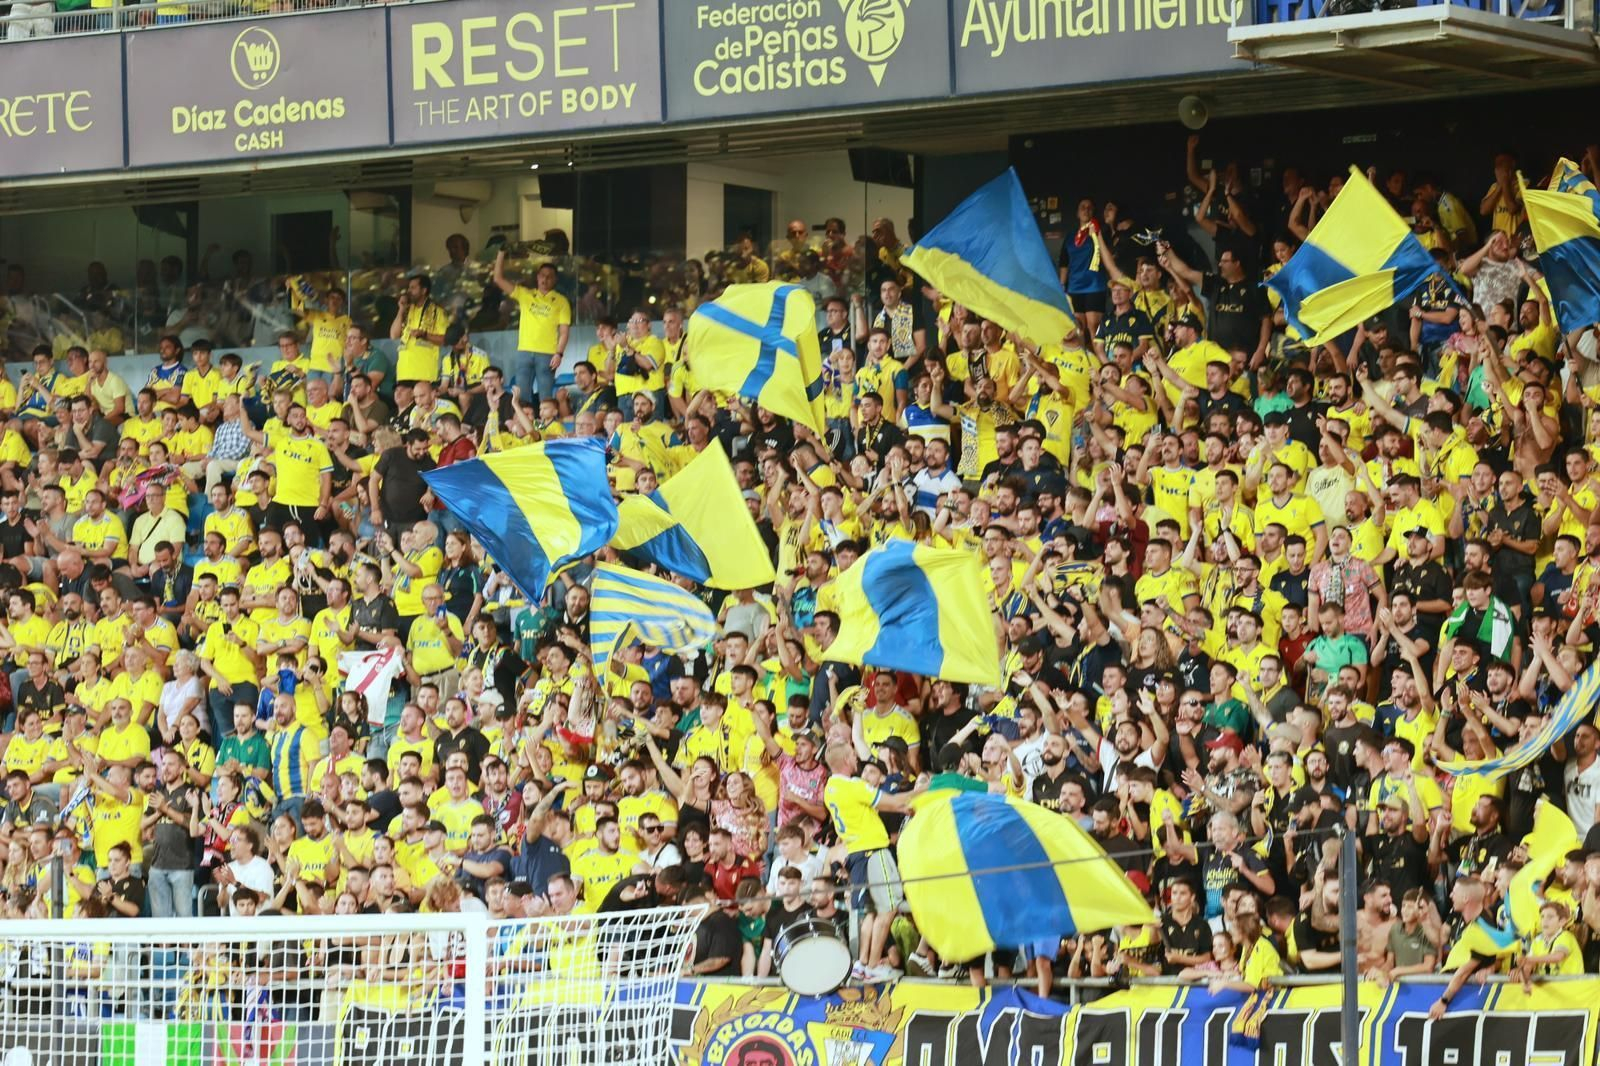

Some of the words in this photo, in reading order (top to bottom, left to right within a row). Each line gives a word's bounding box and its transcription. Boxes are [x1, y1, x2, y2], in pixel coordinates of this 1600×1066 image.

[411, 2, 636, 91] RESET
[714, 37, 743, 61] de
[744, 20, 839, 57] Peñas
[693, 53, 847, 97] Cadistas
[171, 105, 227, 134] Díaz
[233, 95, 345, 128] Cadenas
[413, 98, 460, 126] THE
[464, 93, 514, 123] ART
[518, 90, 552, 117] OF
[561, 82, 637, 114] BODY
[235, 130, 284, 152] CASH
